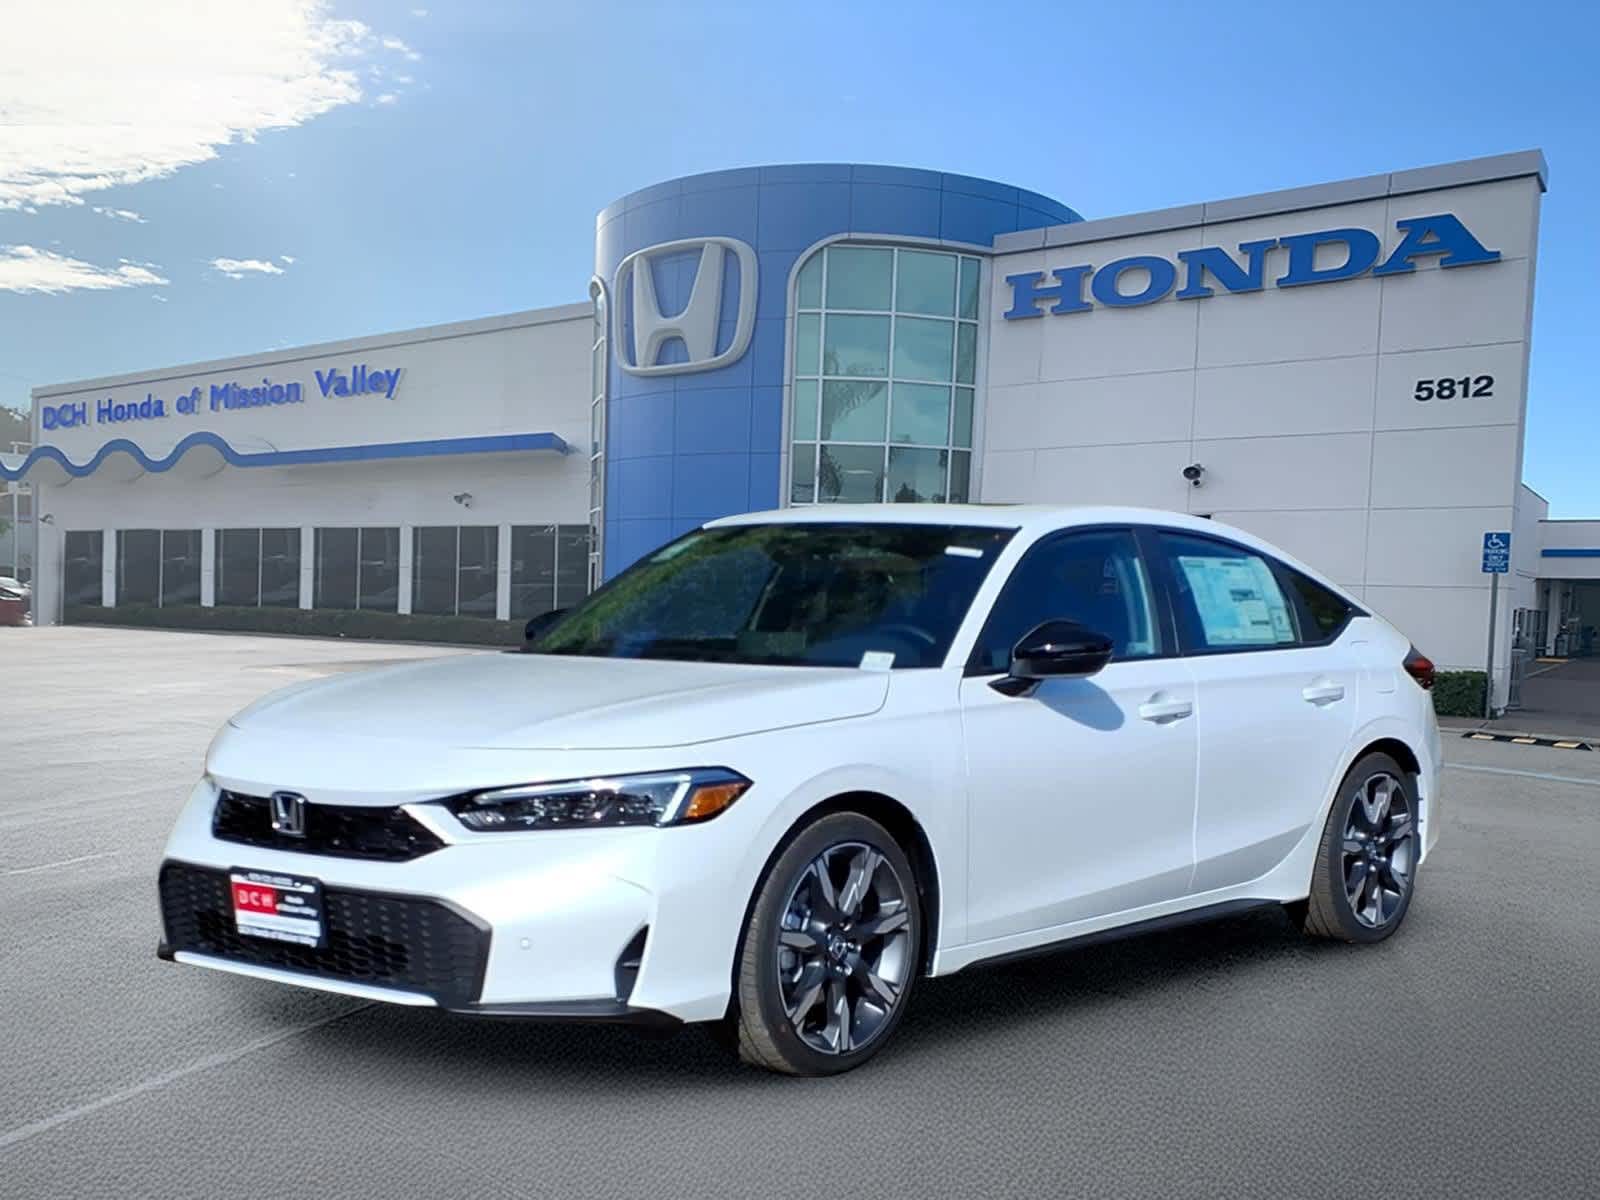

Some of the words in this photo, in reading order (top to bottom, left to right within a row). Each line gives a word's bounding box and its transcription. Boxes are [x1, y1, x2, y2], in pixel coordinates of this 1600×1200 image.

[1003, 213, 1501, 321] HONDA
[42, 401, 87, 431] DCH
[96, 393, 165, 424] Honda
[175, 386, 202, 415] of
[209, 377, 303, 412] Mission
[313, 363, 402, 401] Valley
[1414, 375, 1495, 402] 5812
